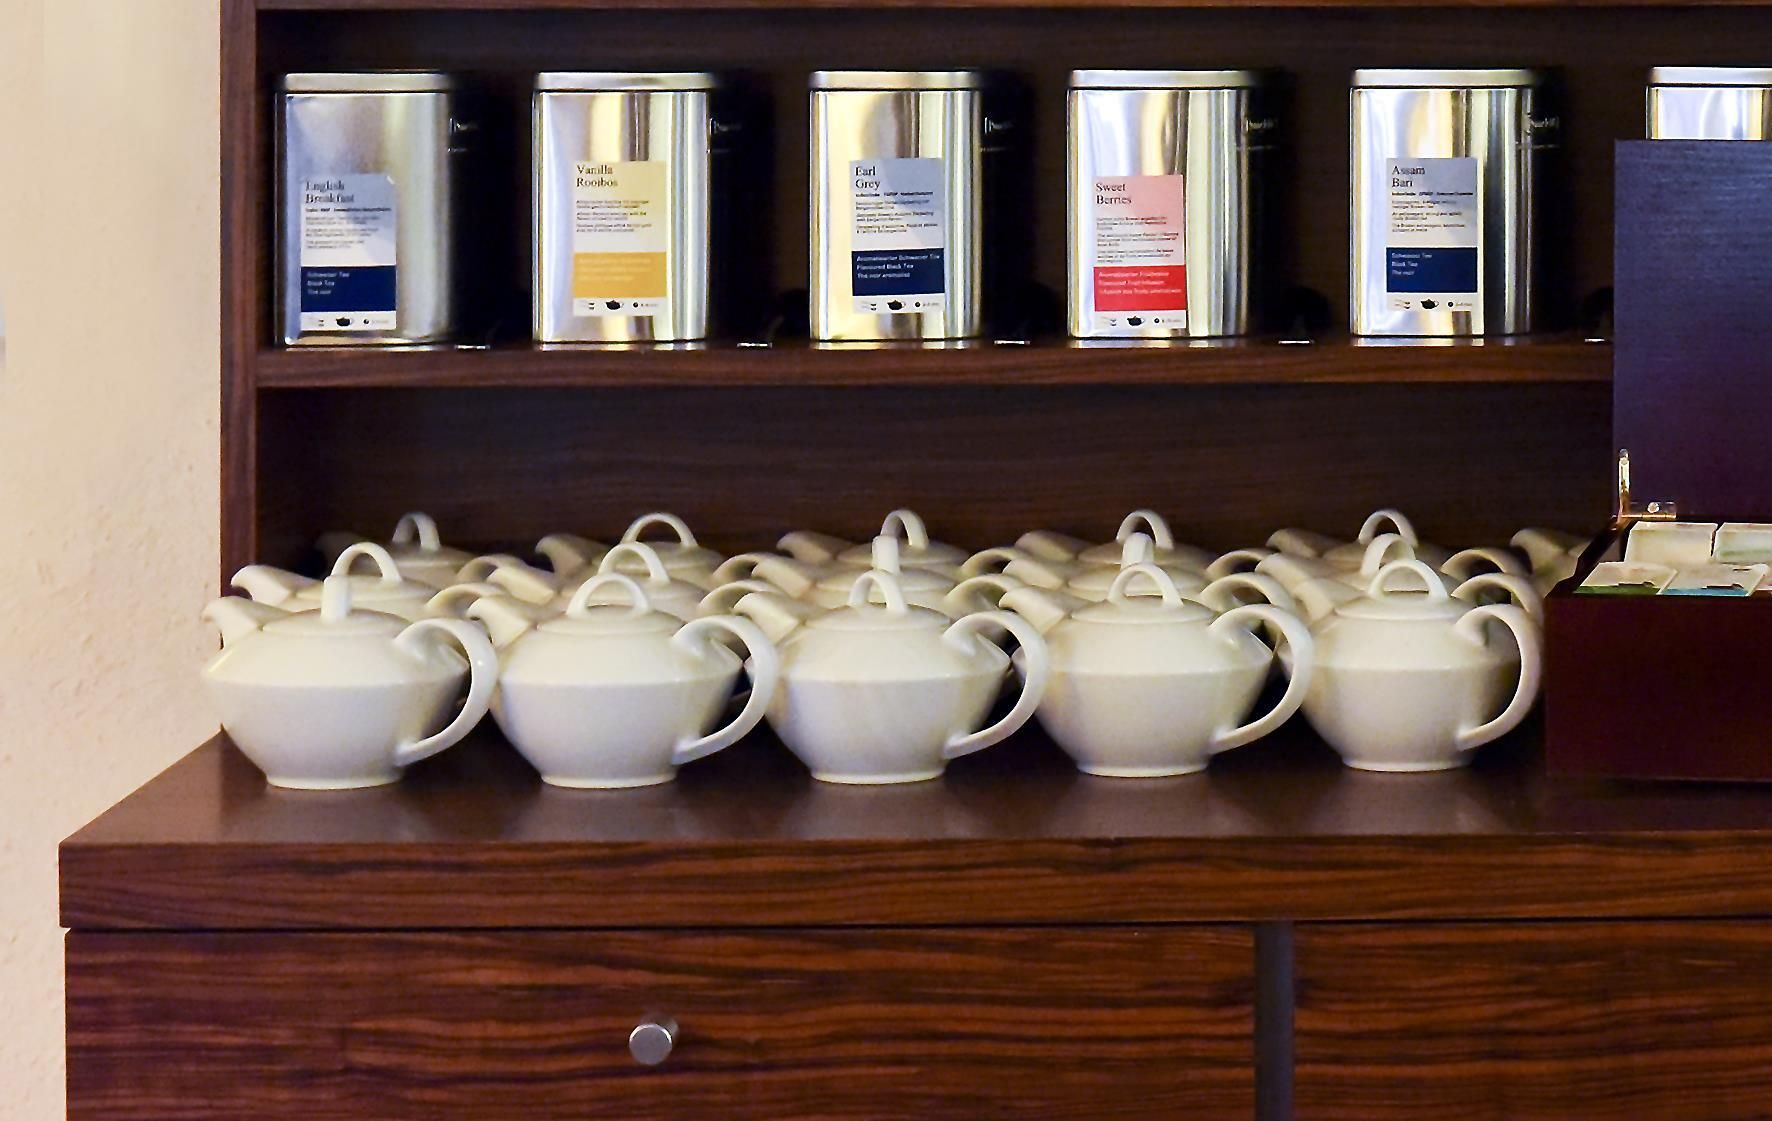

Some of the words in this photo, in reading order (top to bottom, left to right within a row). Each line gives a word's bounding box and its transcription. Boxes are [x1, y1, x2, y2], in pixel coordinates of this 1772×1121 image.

[576, 164, 613, 175] Vanilla
[855, 166, 876, 177] Earl
[1391, 165, 1426, 175] Assam
[305, 180, 345, 193] English
[576, 177, 618, 188] Rooibos
[855, 179, 881, 191] Grey
[1096, 182, 1127, 192] Sweet
[305, 193, 355, 204] Breakfast
[1096, 195, 1132, 205] Berries
